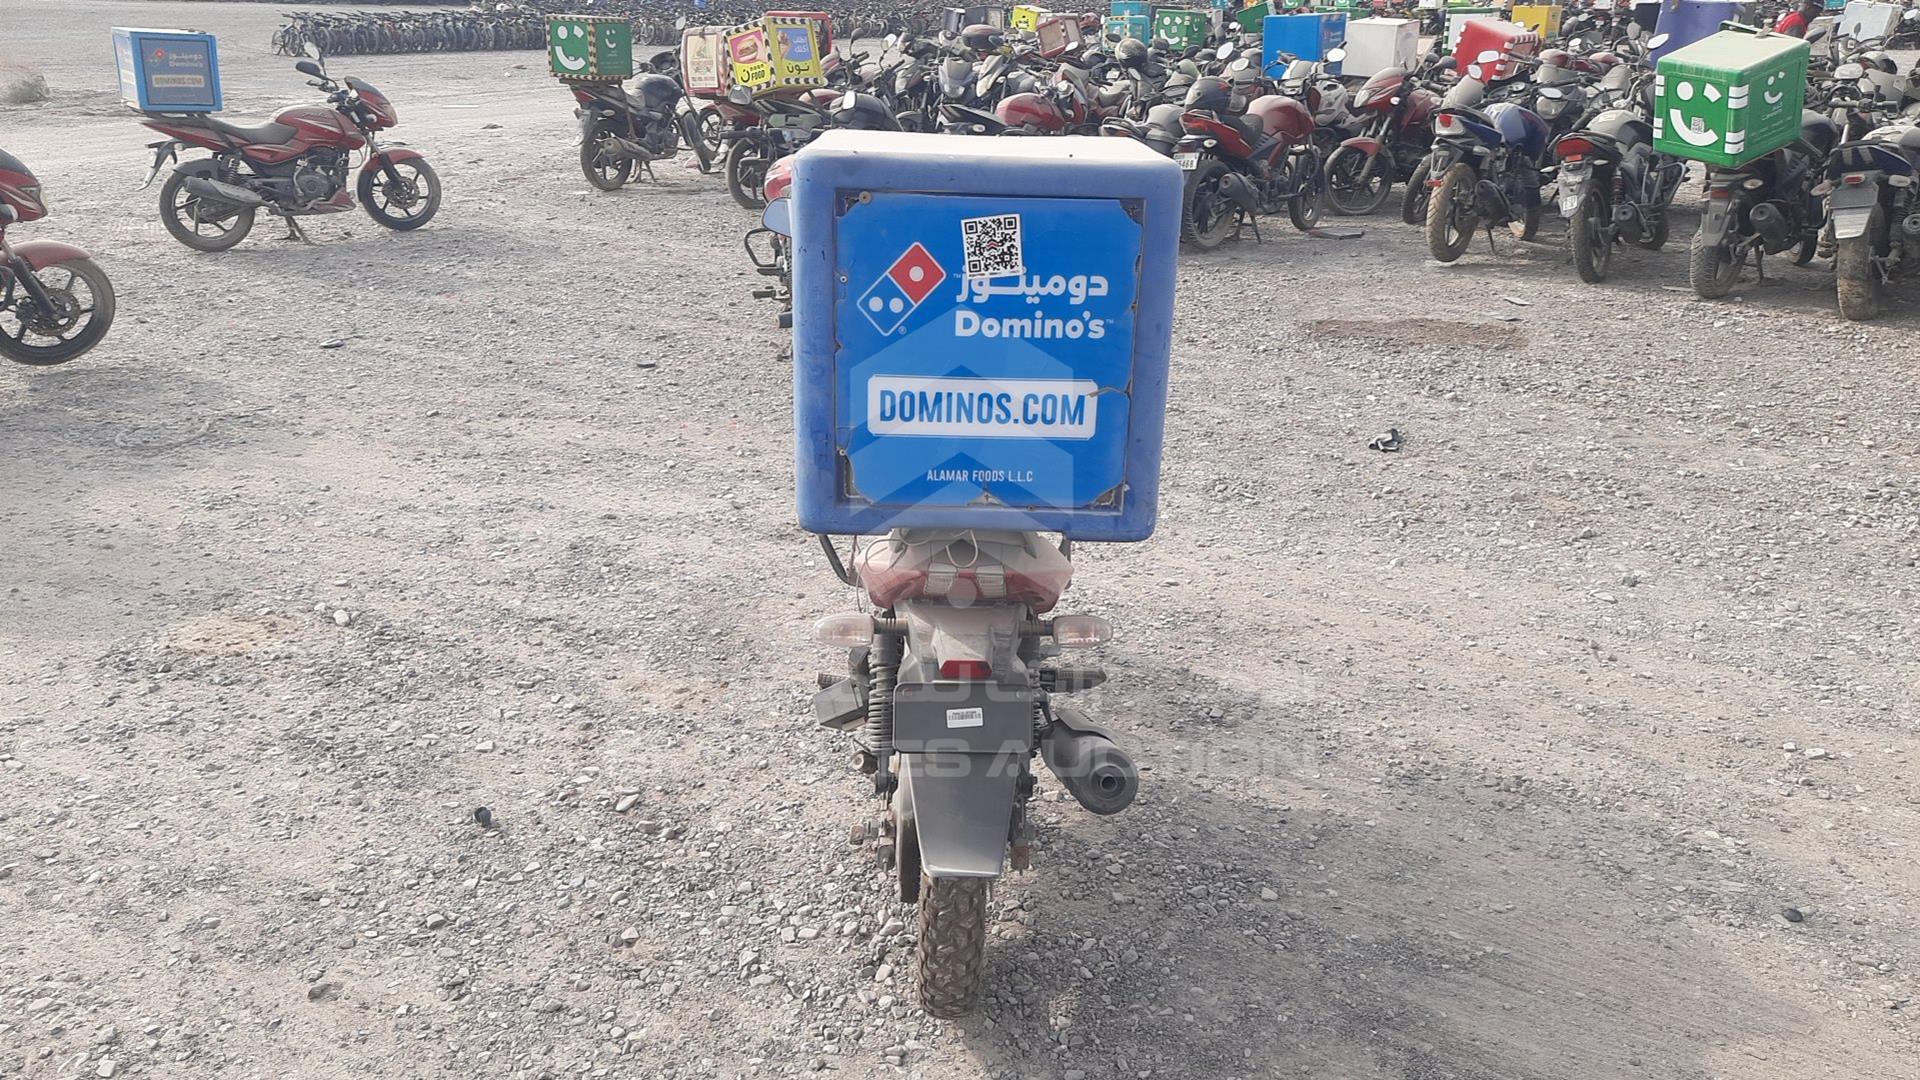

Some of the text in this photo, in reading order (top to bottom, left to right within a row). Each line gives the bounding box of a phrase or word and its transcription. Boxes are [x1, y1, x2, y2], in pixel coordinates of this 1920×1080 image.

[751, 70, 766, 81] FOOD
[955, 311, 1105, 338] Domino's
[880, 390, 1085, 425] DOMINOS.COM
[927, 469, 1033, 482] ALAMAR FOODS L.L.C
